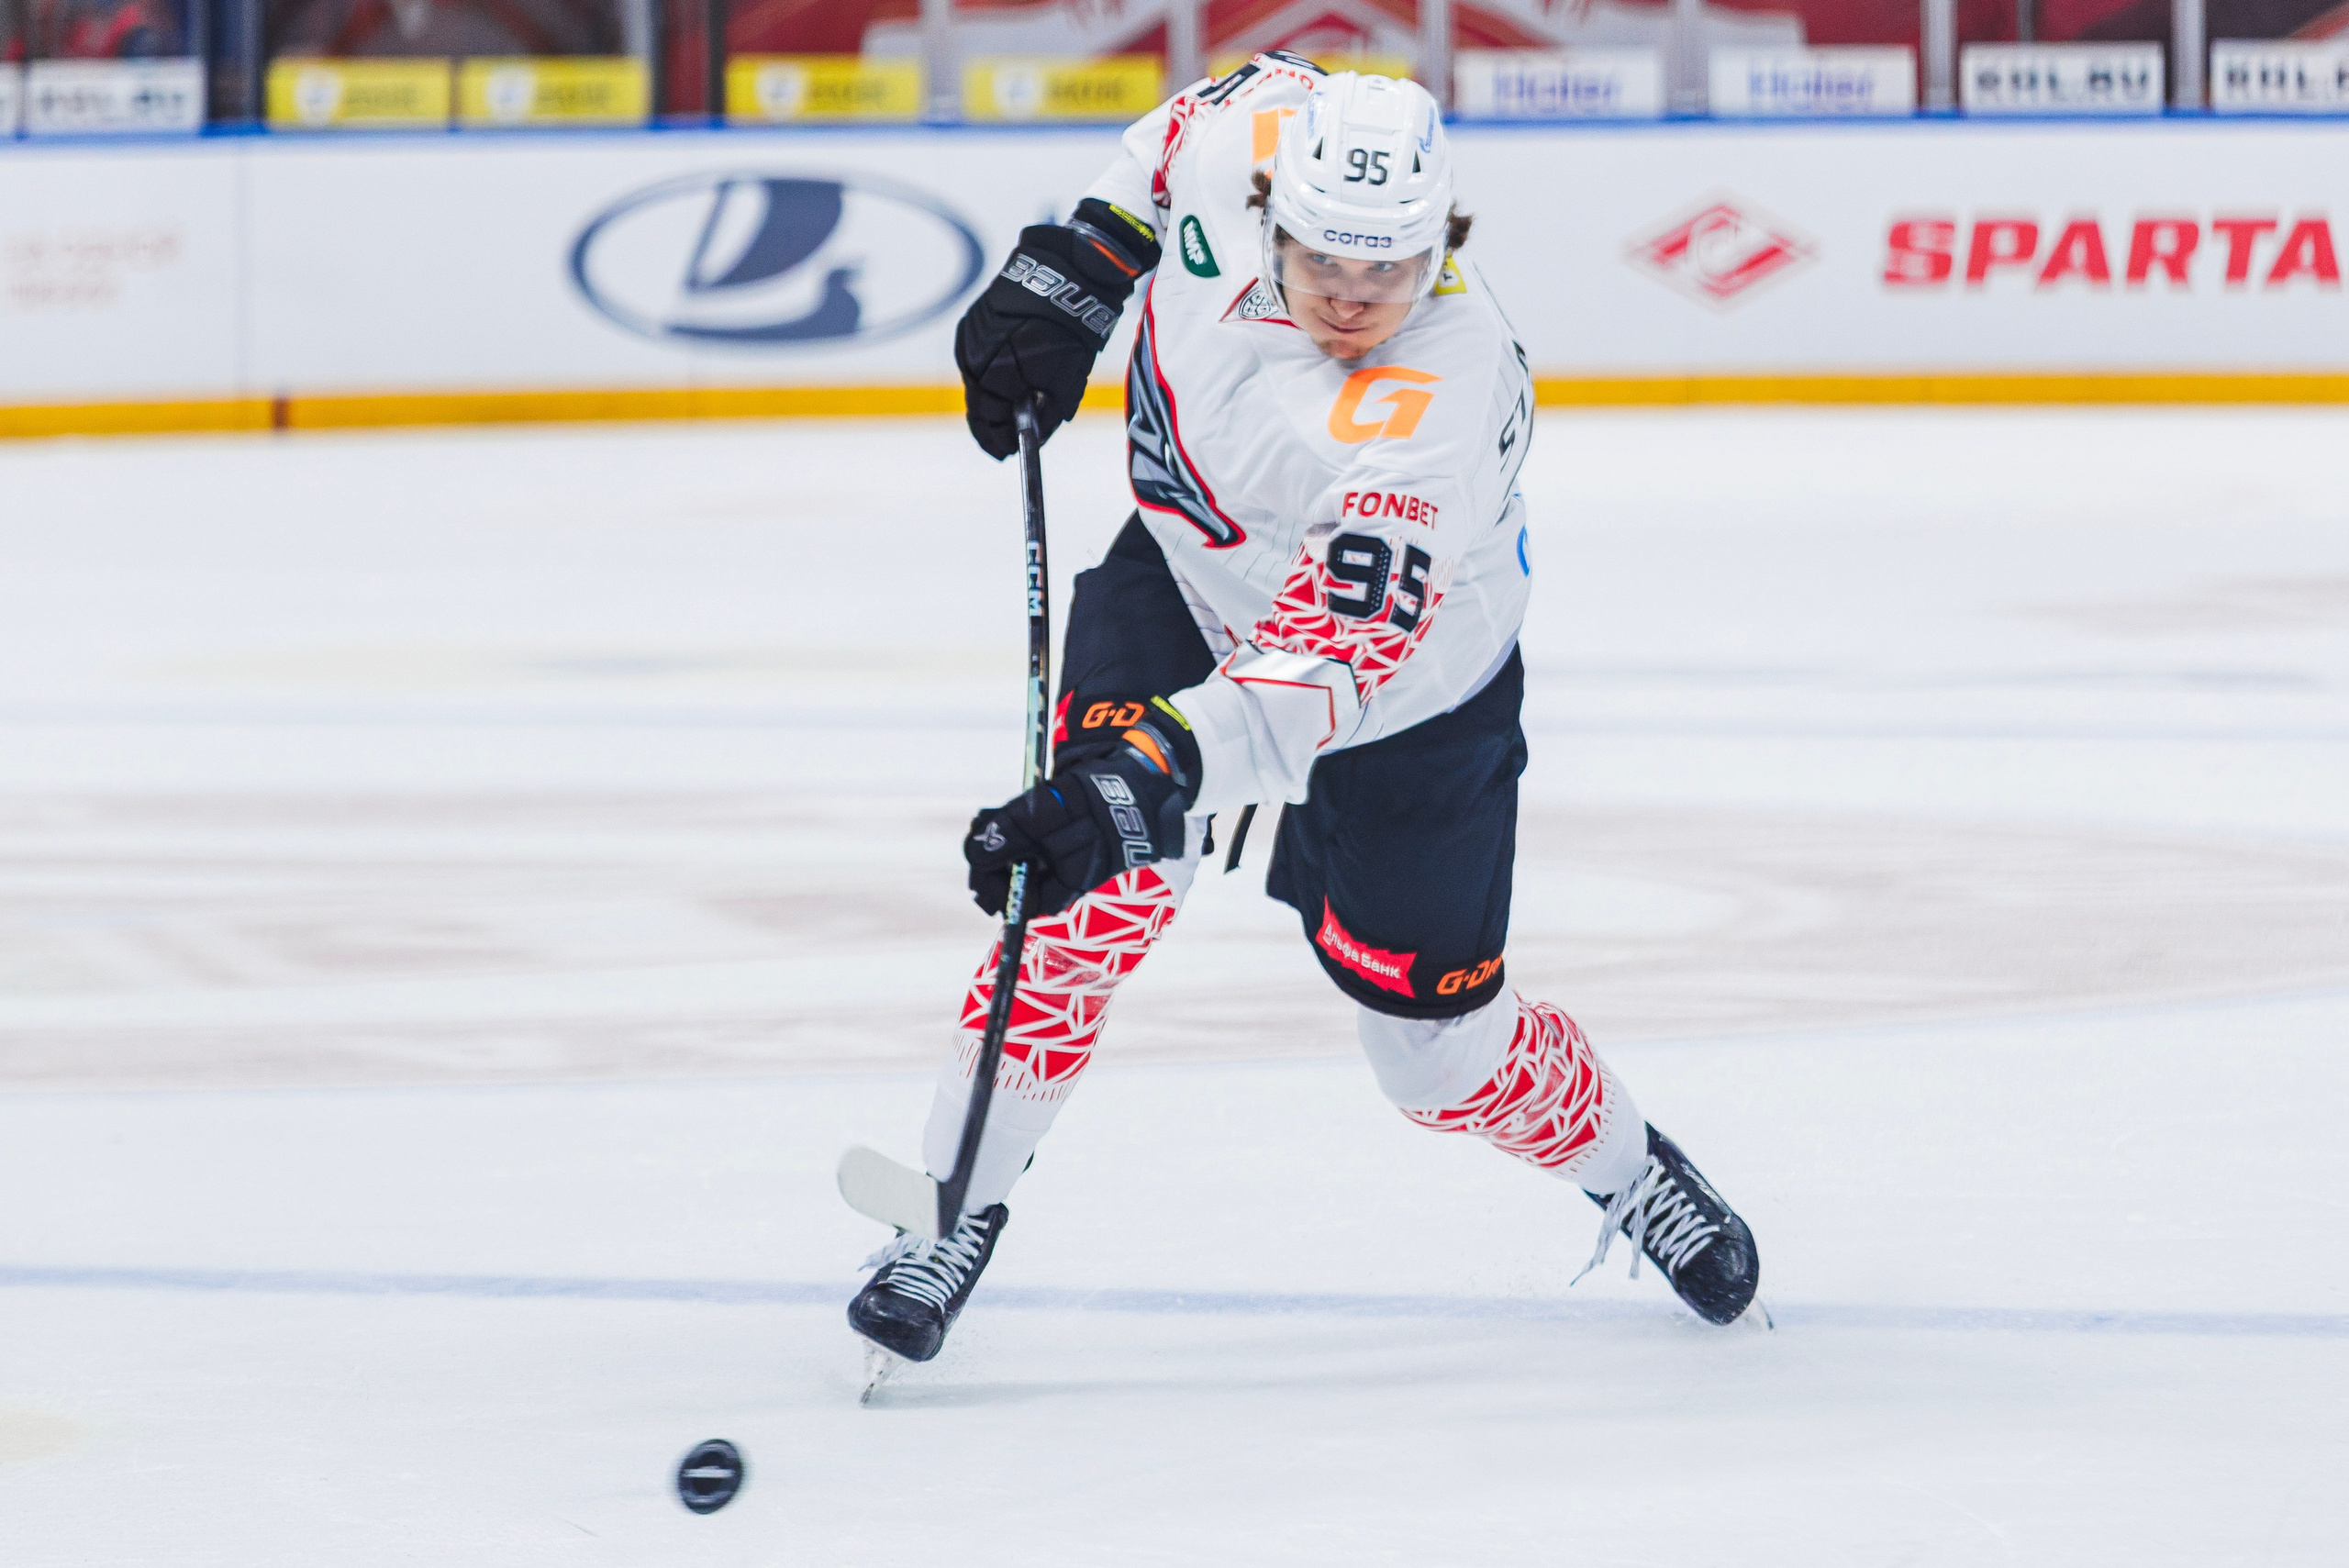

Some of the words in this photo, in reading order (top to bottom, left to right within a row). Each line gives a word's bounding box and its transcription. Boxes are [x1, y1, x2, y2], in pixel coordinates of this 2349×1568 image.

[1342, 148, 1391, 186] 95
[1341, 491, 1440, 530] FONBET
[1026, 539, 1044, 618] CCM
[1325, 531, 1433, 634] 95
